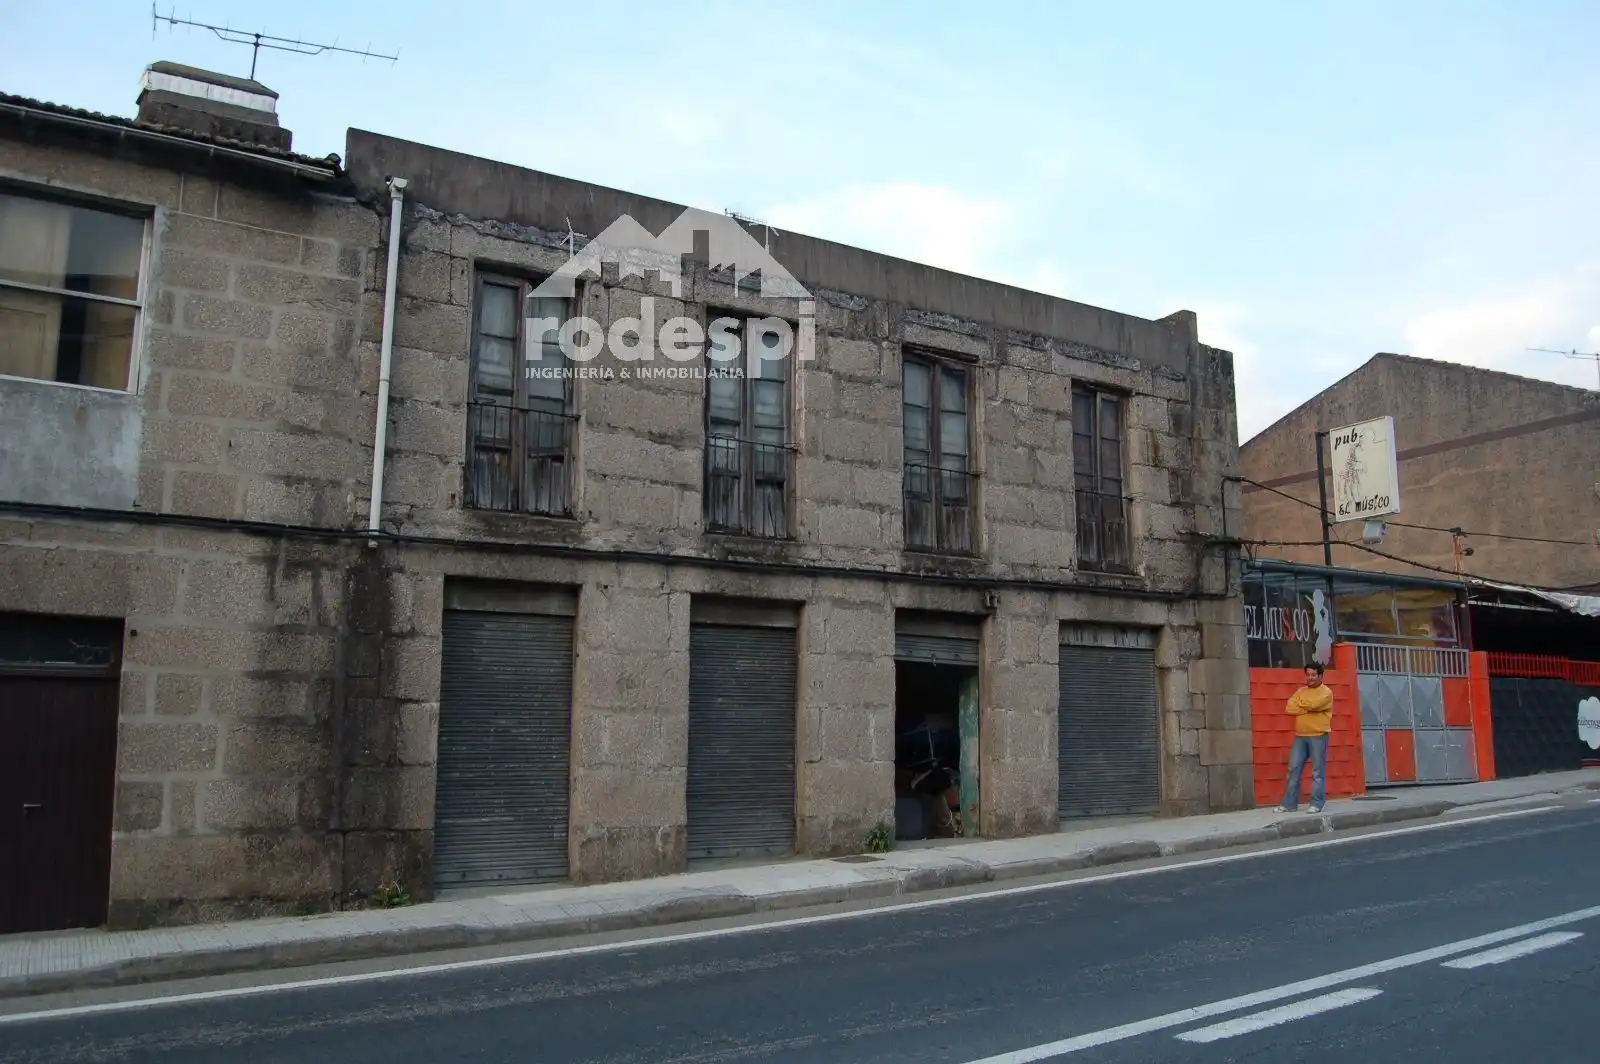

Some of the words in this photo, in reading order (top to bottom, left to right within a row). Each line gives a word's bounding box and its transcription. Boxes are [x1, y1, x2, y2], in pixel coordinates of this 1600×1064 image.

[1334, 427, 1358, 450] pub
[1243, 605, 1261, 639] EL
[1262, 606, 1310, 641] MUSCO
